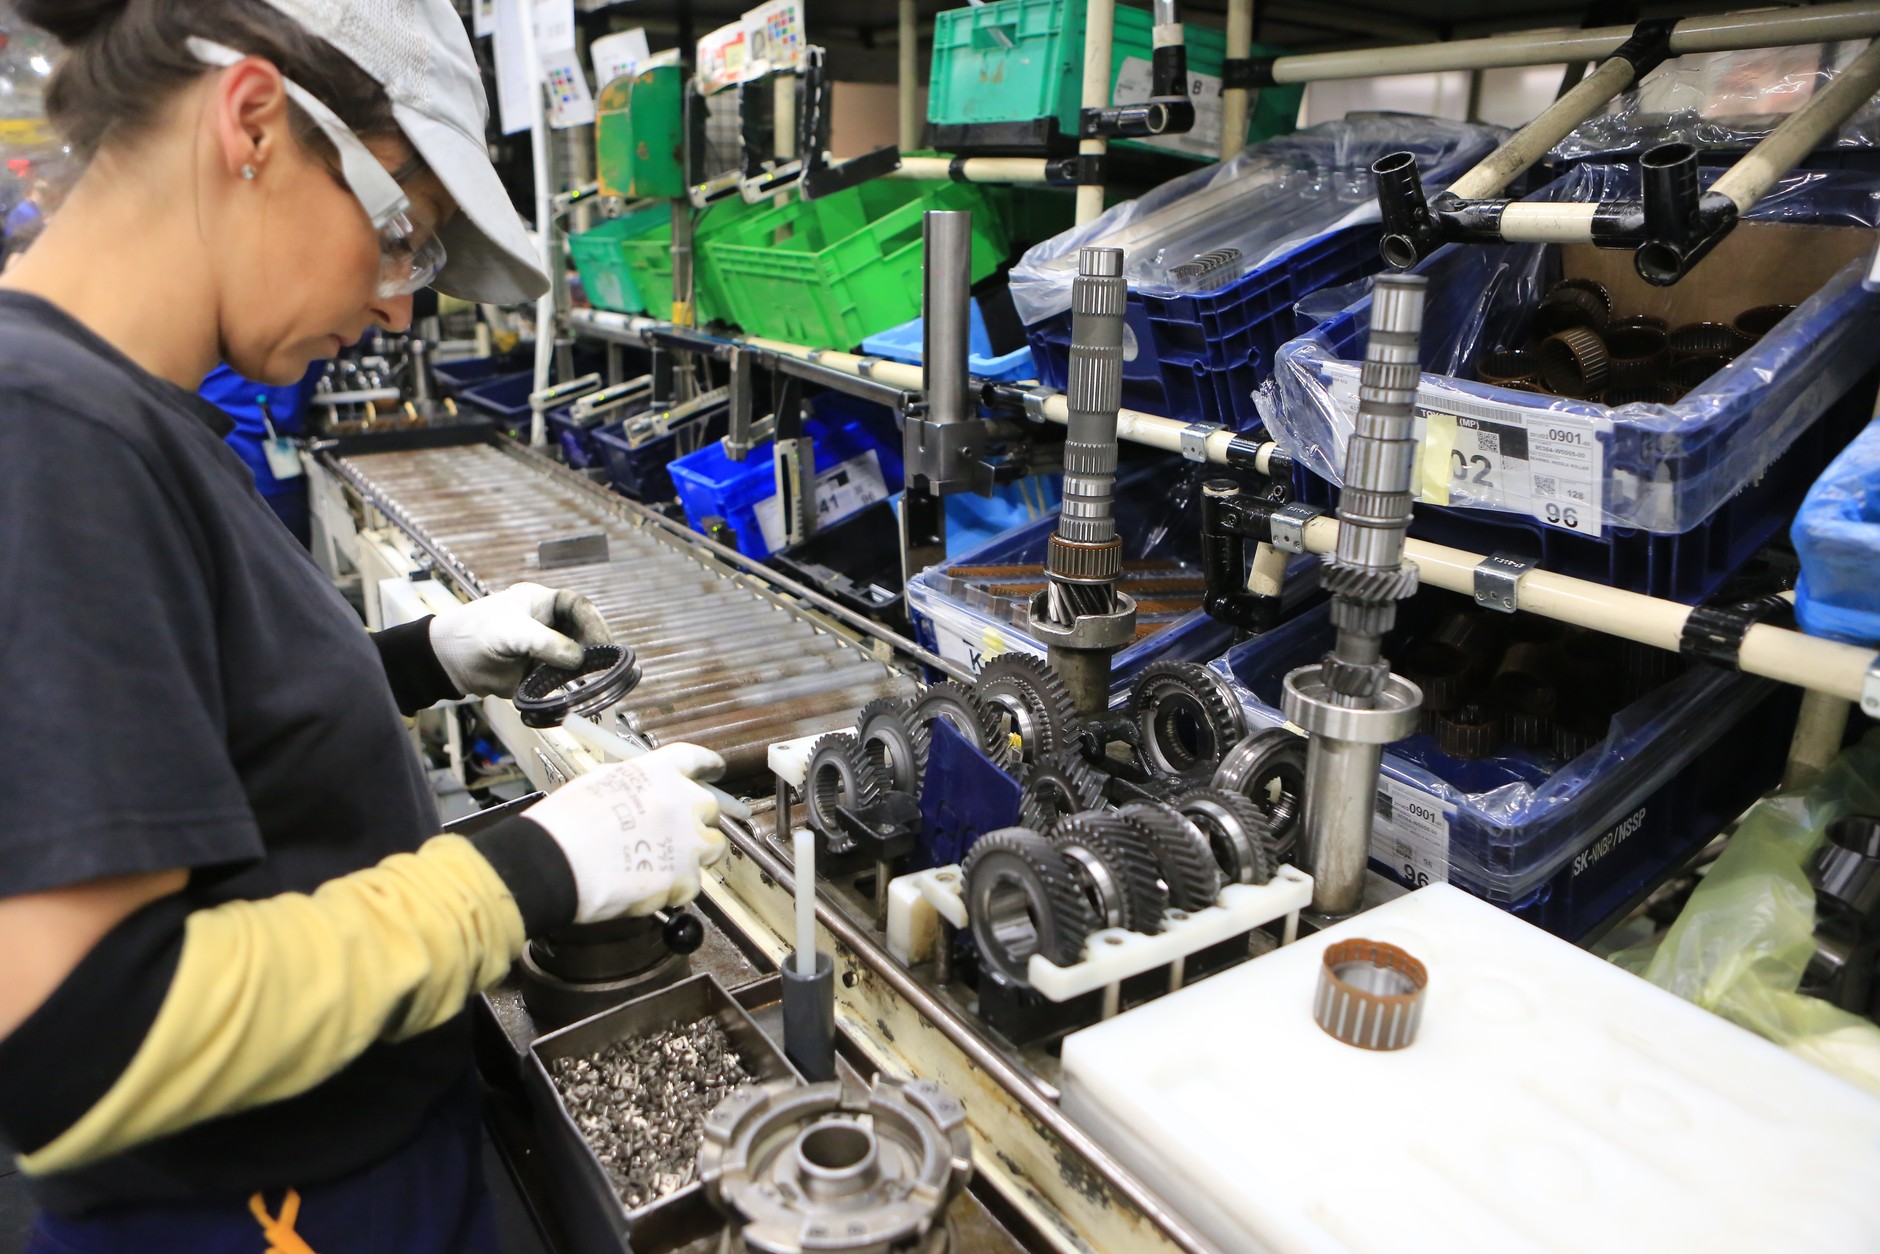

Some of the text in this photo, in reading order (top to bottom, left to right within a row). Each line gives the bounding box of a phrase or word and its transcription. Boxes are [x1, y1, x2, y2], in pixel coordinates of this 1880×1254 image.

[1459, 418, 1480, 431] (MP)
[1549, 428, 1581, 445] 0901
[1545, 502, 1578, 528] 96
[1409, 803, 1436, 823] 0901
[1404, 863, 1430, 888] 96
